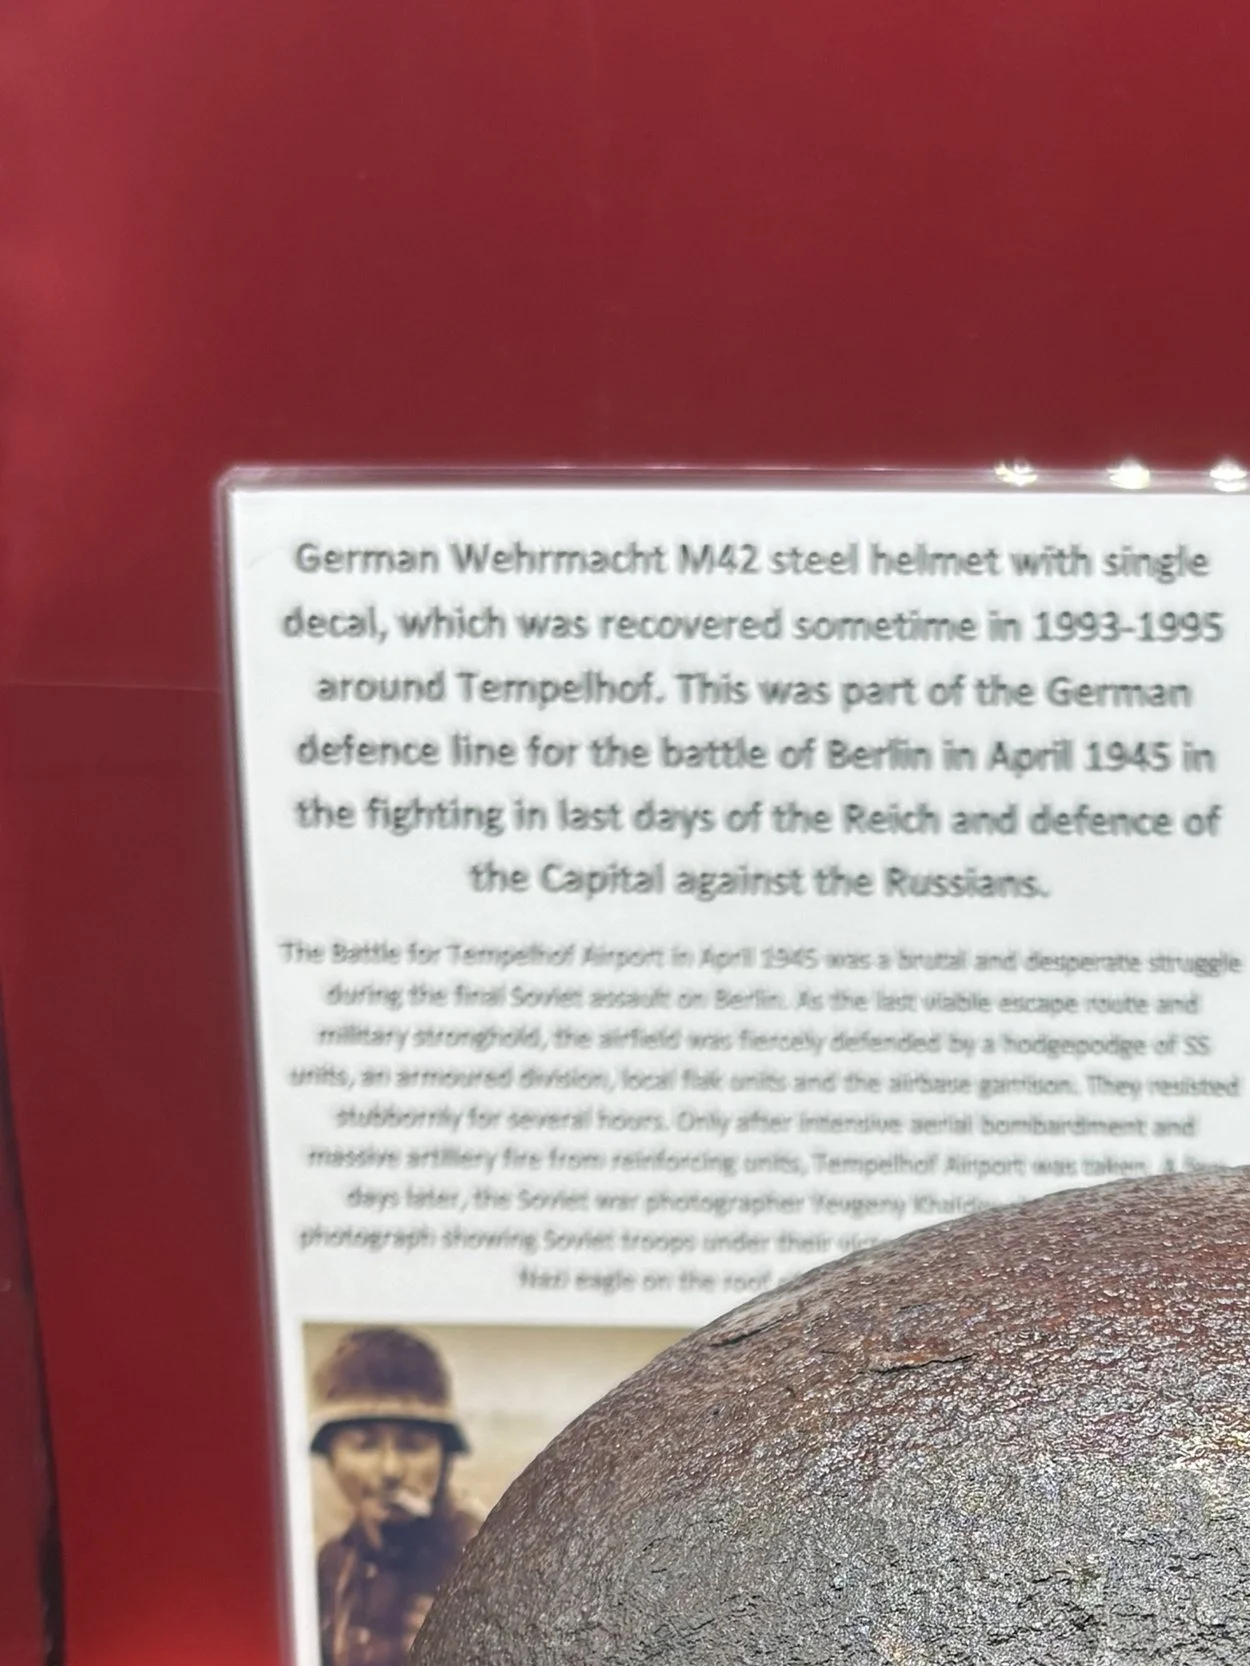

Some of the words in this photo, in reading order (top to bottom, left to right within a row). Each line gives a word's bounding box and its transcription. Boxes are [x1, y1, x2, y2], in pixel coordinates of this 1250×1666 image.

[292, 542, 440, 573] German
[448, 541, 668, 574] Wehrmacht
[676, 543, 760, 574] M42
[769, 542, 860, 575] steel
[868, 542, 1002, 576] helmet
[1008, 543, 1094, 576] with
[1102, 545, 1210, 585] single
[281, 605, 388, 643] decal,
[397, 605, 507, 638] which
[515, 614, 590, 639] was
[599, 608, 783, 640] recovered
[794, 610, 978, 641] sometime
[988, 610, 1023, 641] in
[1034, 611, 1225, 643] 1993-1995
[316, 669, 447, 702] around
[456, 670, 665, 709] Tempelhof.
[675, 672, 750, 704] This
[757, 680, 832, 705] was
[840, 678, 918, 713] part
[926, 673, 966, 706] of
[974, 674, 1036, 707] the
[1044, 677, 1193, 708] German
[296, 733, 439, 765] defence
[450, 732, 516, 767] line
[527, 734, 578, 767] for
[589, 735, 650, 768] the
[660, 736, 767, 769] battle
[778, 737, 816, 769] of
[826, 737, 932, 770] Berlin
[943, 739, 976, 771] in
[987, 738, 1073, 779] April
[1087, 740, 1172, 772] 1945
[1182, 740, 1215, 772] in
[296, 795, 354, 829] the
[366, 796, 504, 837] fighting
[515, 797, 547, 830] in
[559, 799, 621, 832] last
[633, 799, 714, 839] days
[726, 800, 762, 832] of
[772, 801, 831, 833] the
[843, 802, 940, 834] Reich
[952, 803, 1017, 835] and
[1029, 804, 1172, 836] defence
[1184, 804, 1220, 837] of
[472, 860, 526, 893] the
[542, 862, 661, 900] Capital
[679, 865, 800, 902] against
[817, 865, 870, 897] the
[887, 866, 1051, 897] Russians.
[279, 939, 326, 965] The
[330, 941, 402, 965] Battle
[405, 940, 442, 966] for
[446, 942, 576, 968] Tempelhof
[581, 944, 665, 970] Airport
[699, 946, 755, 971] April
[761, 946, 820, 970] 1945
[824, 952, 872, 970] was
[896, 949, 968, 972] brutal
[973, 950, 1019, 972] and
[1022, 950, 1143, 974] desperate
[1147, 951, 1243, 979] struggle
[325, 983, 404, 1011] during
[406, 982, 449, 1007] the
[452, 982, 507, 1007] final
[509, 984, 584, 1009] Soviet
[589, 987, 672, 1010] assault
[828, 989, 869, 1012] the
[875, 990, 918, 1013] last
[921, 991, 994, 1014] viable
[996, 995, 1080, 1015] escape
[1084, 994, 1150, 1015] route
[1154, 992, 1201, 1015] and
[317, 1024, 410, 1050] military
[412, 1024, 548, 1053] stronghold,
[551, 1026, 594, 1050] the
[598, 1026, 683, 1051] airfield
[685, 1033, 733, 1051] was
[737, 1028, 827, 1055] fiercely
[829, 1030, 944, 1054] defended
[999, 1033, 1148, 1061] hodgepodge
[1151, 1032, 1180, 1057] of
[1182, 1034, 1212, 1057] SS
[396, 1067, 515, 1089] armoured
[619, 1067, 676, 1091] local
[729, 1071, 787, 1093] units
[793, 1071, 838, 1094] and
[843, 1071, 882, 1094] the
[888, 1072, 973, 1095] airbase
[1085, 1073, 1143, 1100] They
[1146, 1074, 1241, 1097] resisted
[334, 1105, 464, 1131] stubbornly
[466, 1105, 502, 1130] for
[506, 1109, 593, 1131] several
[675, 1109, 732, 1136] Only
[735, 1109, 793, 1133] after
[798, 1113, 904, 1134] intensive
[909, 1115, 974, 1135] aerial
[979, 1114, 1148, 1136] bombardment
[1152, 1115, 1198, 1139] and
[308, 1147, 400, 1170] massive
[405, 1146, 497, 1173] artillery
[503, 1146, 541, 1170] fire
[549, 1147, 605, 1170] from
[612, 1148, 737, 1178] reinforcing
[812, 1152, 938, 1178] Tempelhof
[945, 1155, 1026, 1179] Airport
[1031, 1159, 1078, 1178] was
[346, 1185, 401, 1213] days
[405, 1187, 468, 1212] later,
[517, 1188, 590, 1212] Soviet
[645, 1191, 804, 1217] photographer
[301, 1227, 437, 1254] photograph
[444, 1227, 538, 1256] showing
[546, 1228, 616, 1253] Soviet
[622, 1230, 696, 1255] troops
[704, 1229, 769, 1253] under
